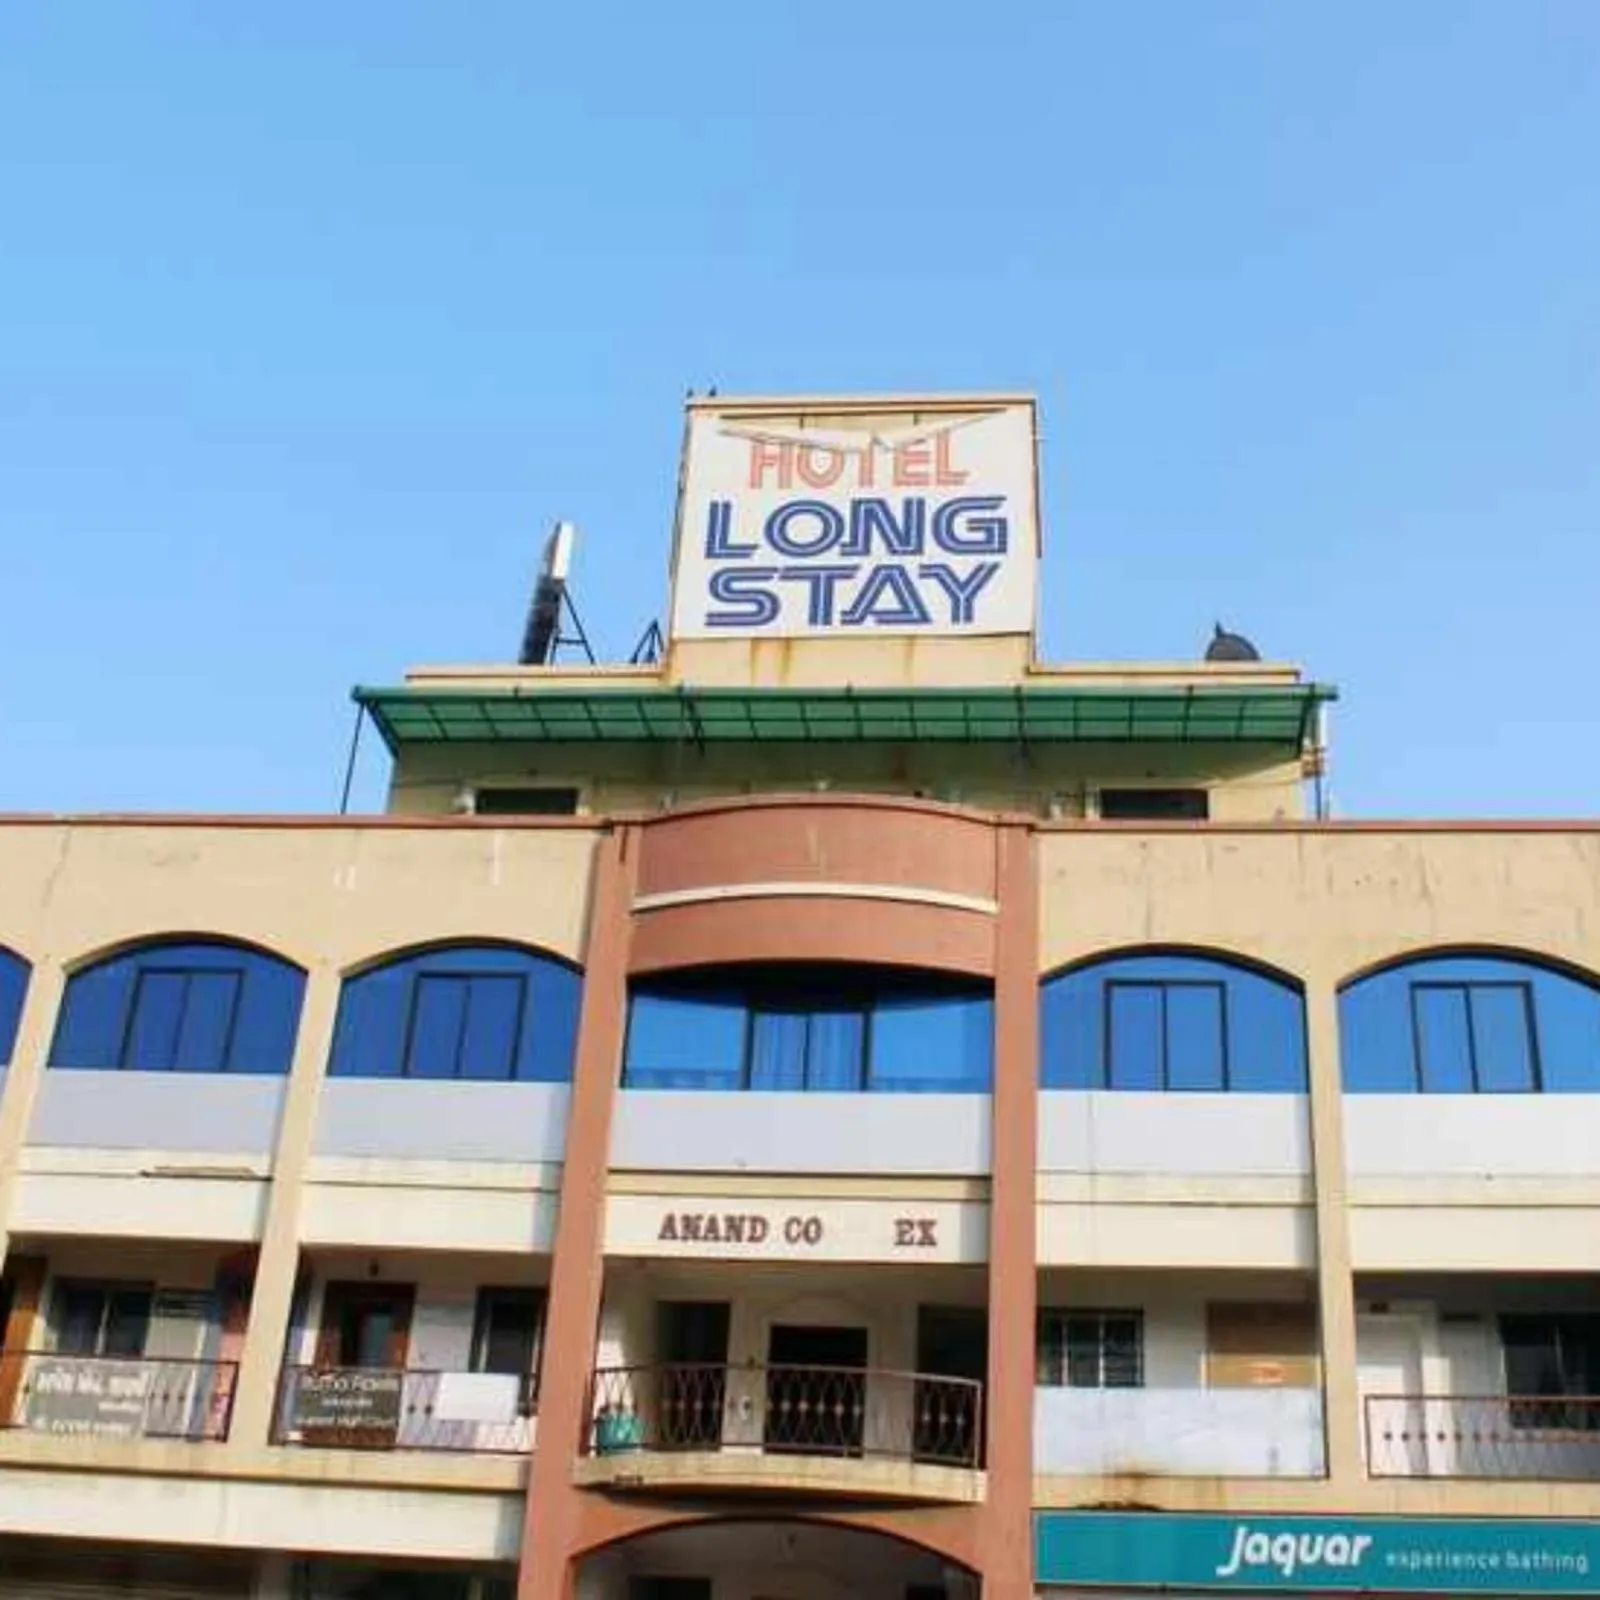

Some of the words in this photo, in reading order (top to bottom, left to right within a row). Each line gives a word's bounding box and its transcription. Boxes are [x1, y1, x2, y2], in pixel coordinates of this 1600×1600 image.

[749, 429, 969, 489] HOTEL
[705, 496, 1007, 559] LONG
[704, 562, 999, 626] STAY
[658, 1212, 768, 1243] ANAND
[1216, 1525, 1372, 1577] Jaquar
[1385, 1551, 1499, 1570] experience
[1506, 1550, 1589, 1574] bathing
